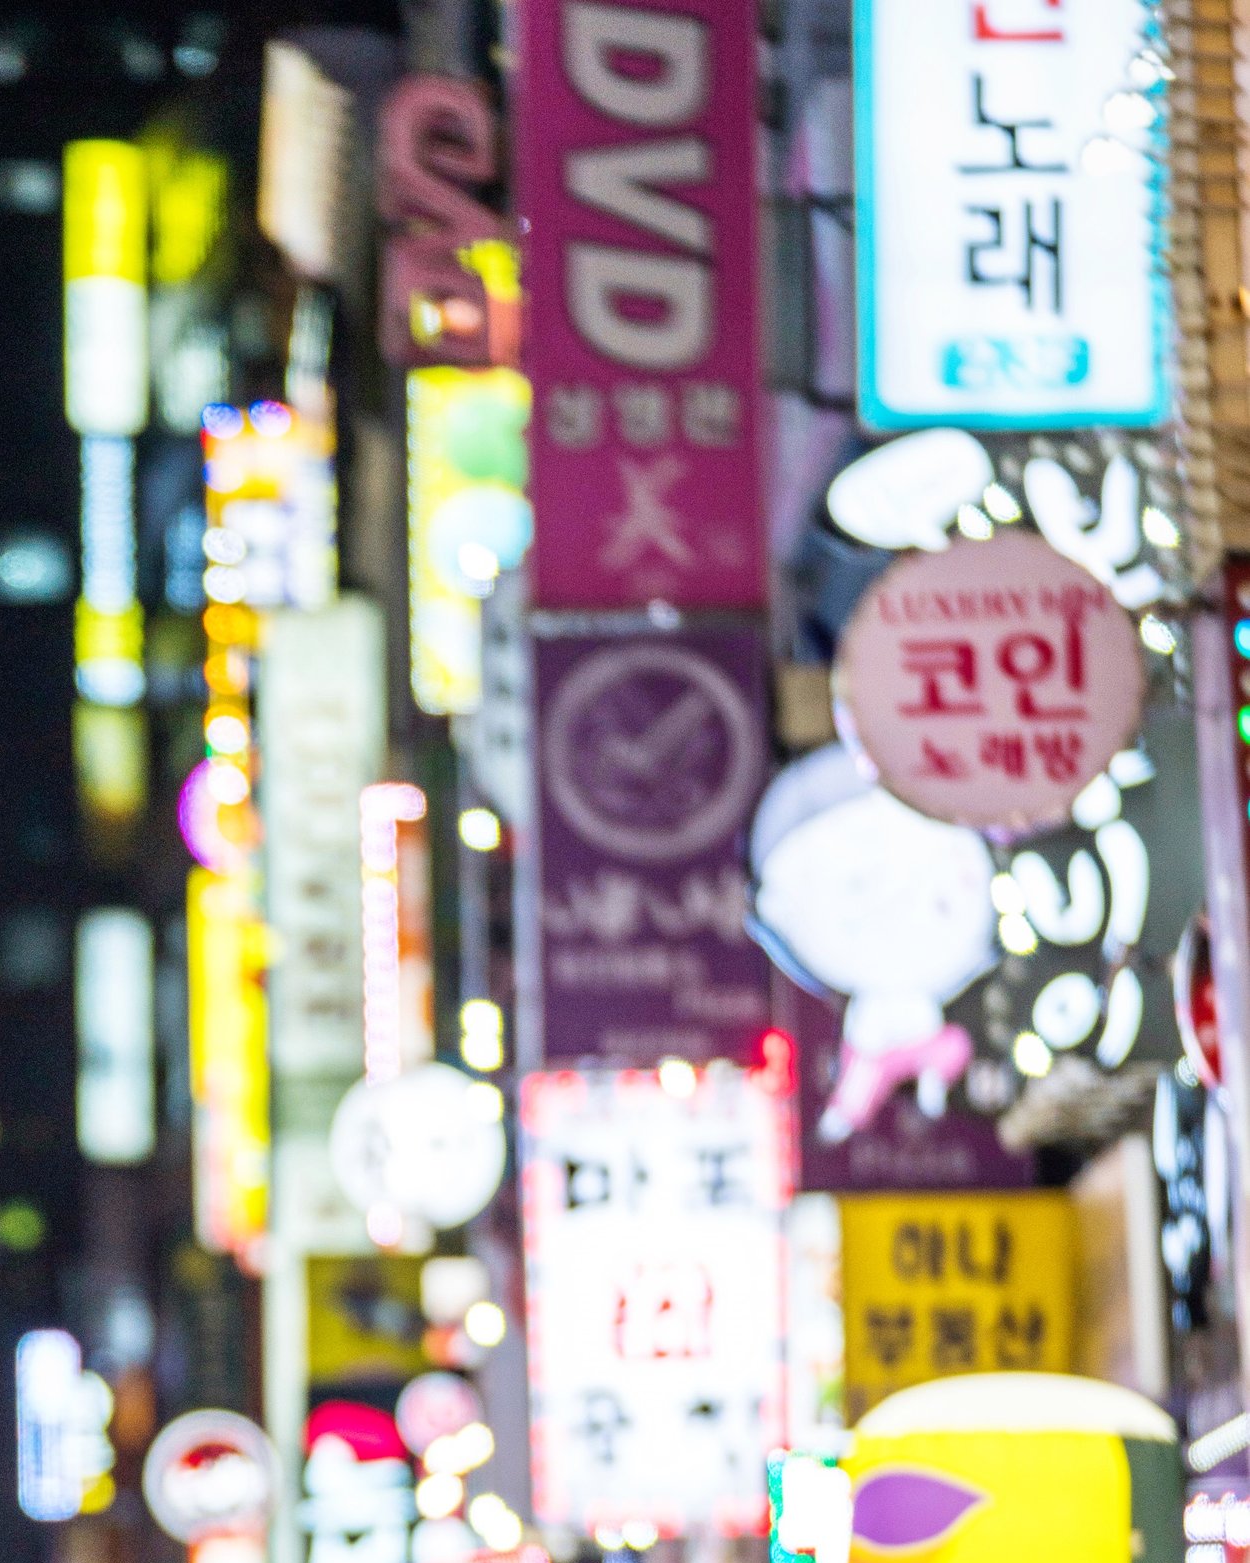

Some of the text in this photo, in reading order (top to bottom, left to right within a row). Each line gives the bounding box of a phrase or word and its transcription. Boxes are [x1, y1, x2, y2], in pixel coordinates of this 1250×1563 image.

[562, 4, 712, 372] DVD
[955, 70, 1068, 314] 노래
[896, 592, 1092, 722] 코인
[912, 730, 1084, 782] 노래방
[865, 1306, 1046, 1373] 부동산
